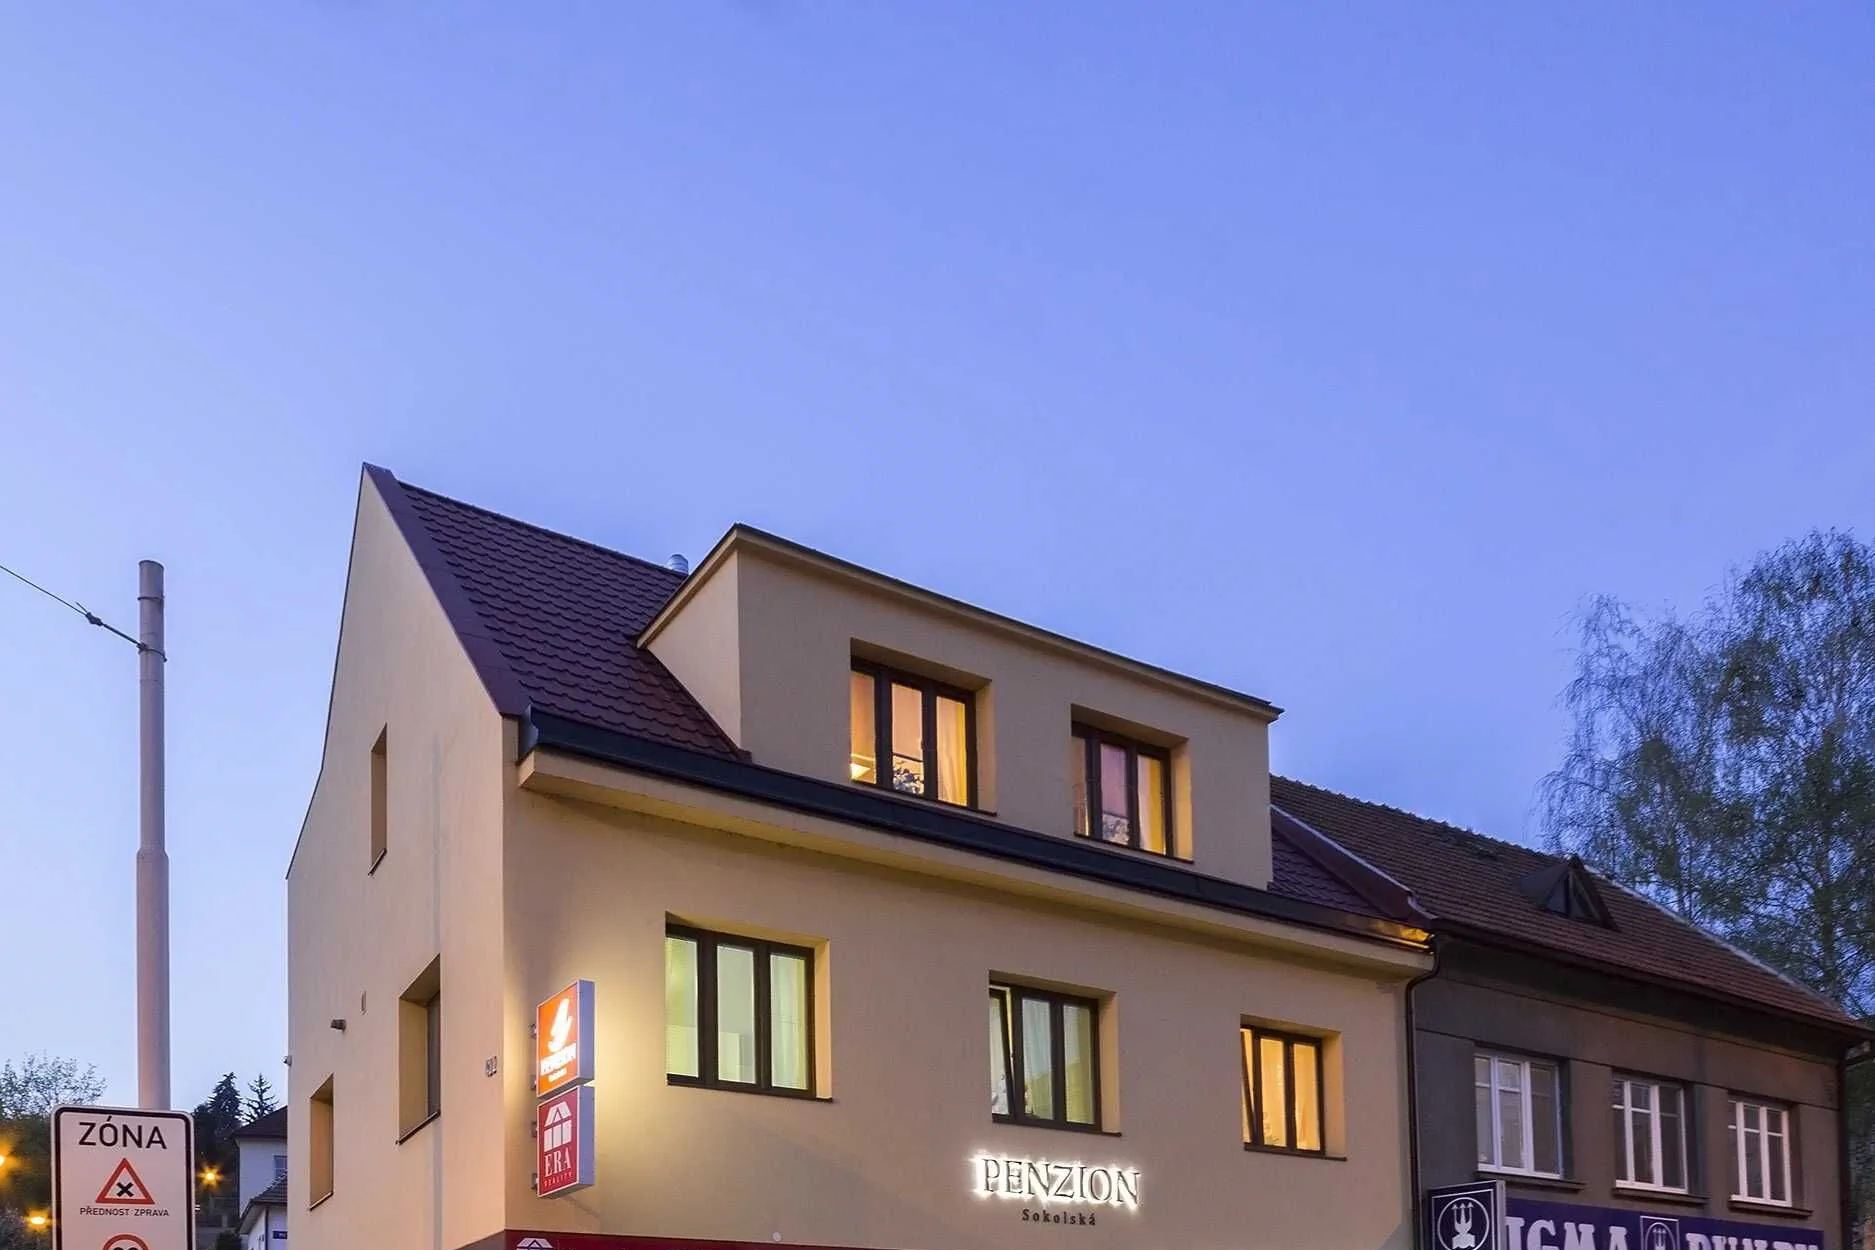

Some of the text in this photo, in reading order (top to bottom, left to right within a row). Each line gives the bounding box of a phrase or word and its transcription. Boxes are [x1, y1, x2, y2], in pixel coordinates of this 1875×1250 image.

[78, 1115, 168, 1150] ZÓNA
[544, 1146, 572, 1178] ERA
[980, 1157, 1141, 1206] PENZION
[79, 1205, 169, 1218] PŘEDNOST ZPRAVA
[1021, 1208, 1096, 1226] Sokolská
